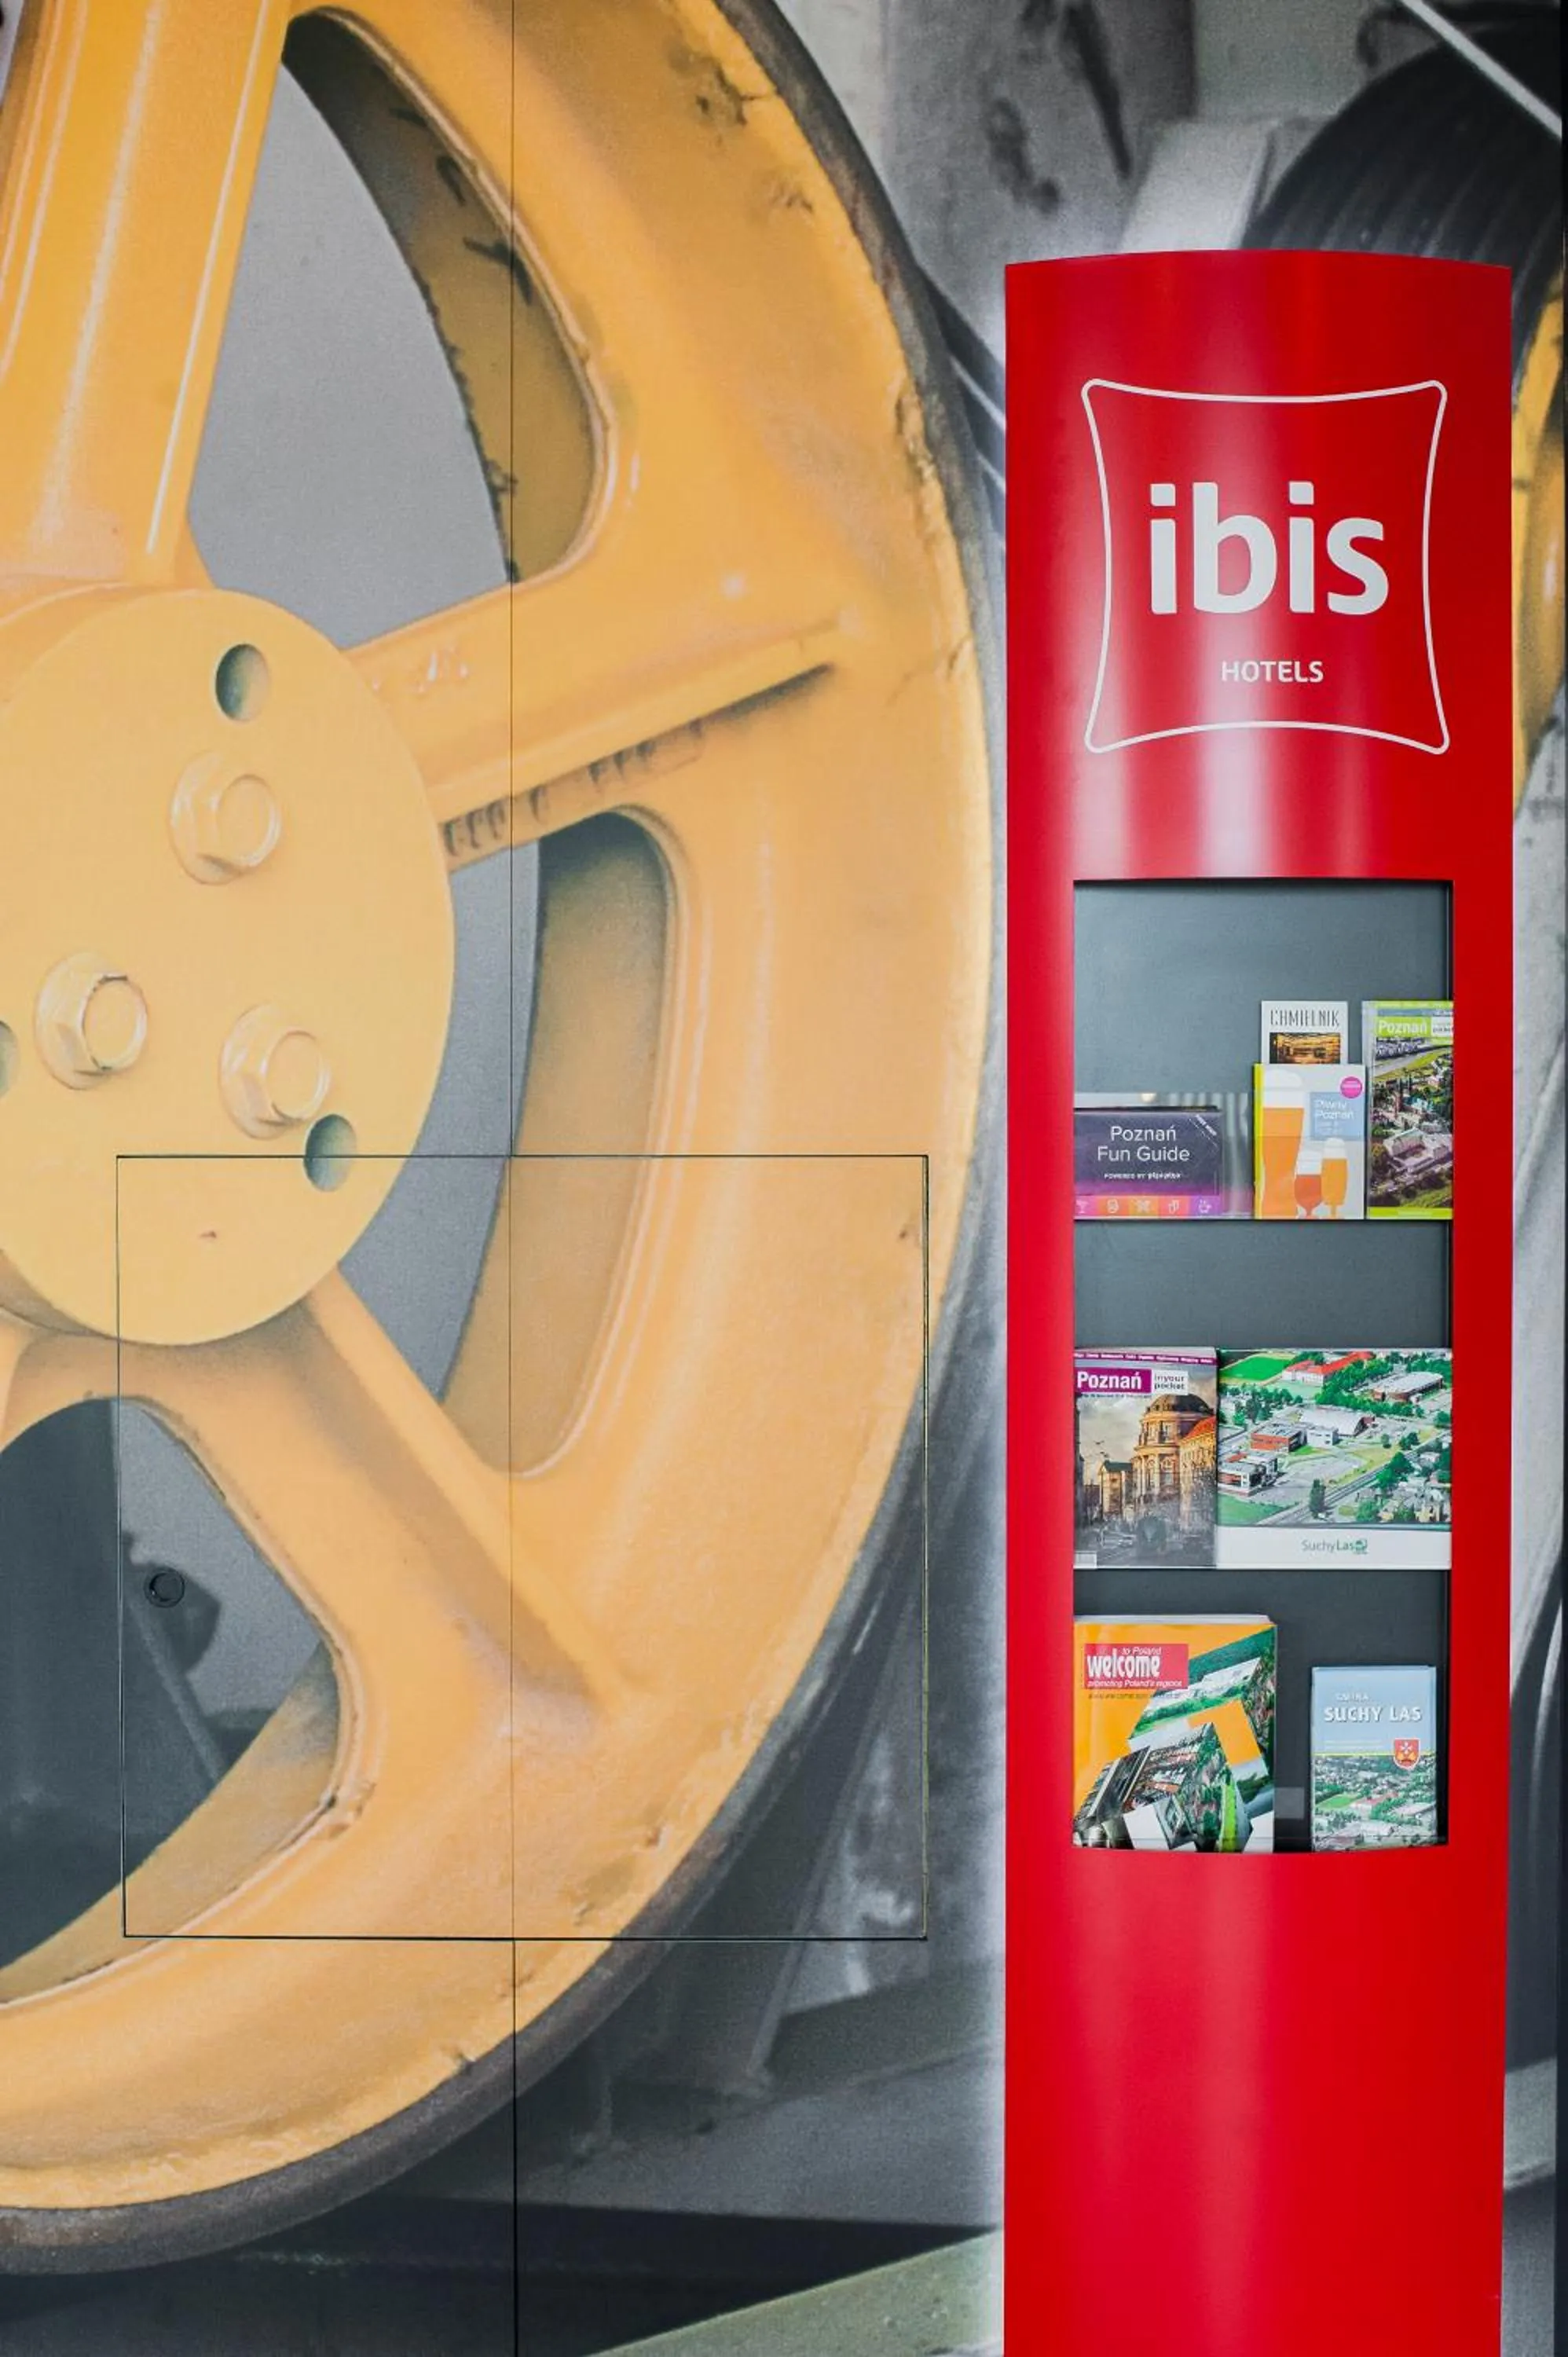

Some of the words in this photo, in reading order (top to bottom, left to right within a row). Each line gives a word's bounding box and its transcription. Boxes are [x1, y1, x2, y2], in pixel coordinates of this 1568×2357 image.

[1150, 481, 1389, 615] ibis
[1222, 661, 1324, 683] HOTELS
[1269, 1009, 1339, 1027] CHMIELNIK
[1378, 1017, 1427, 1035] Poznań
[1110, 1124, 1177, 1142] Poznań
[1097, 1146, 1130, 1162] Fun
[1137, 1146, 1190, 1162] Guide
[1077, 1371, 1142, 1390] Poznań
[1132, 1646, 1162, 1655] Poland
[1086, 1648, 1161, 1678] welcome
[1324, 1706, 1383, 1722] SUCHY
[1389, 1706, 1422, 1722] LAS
